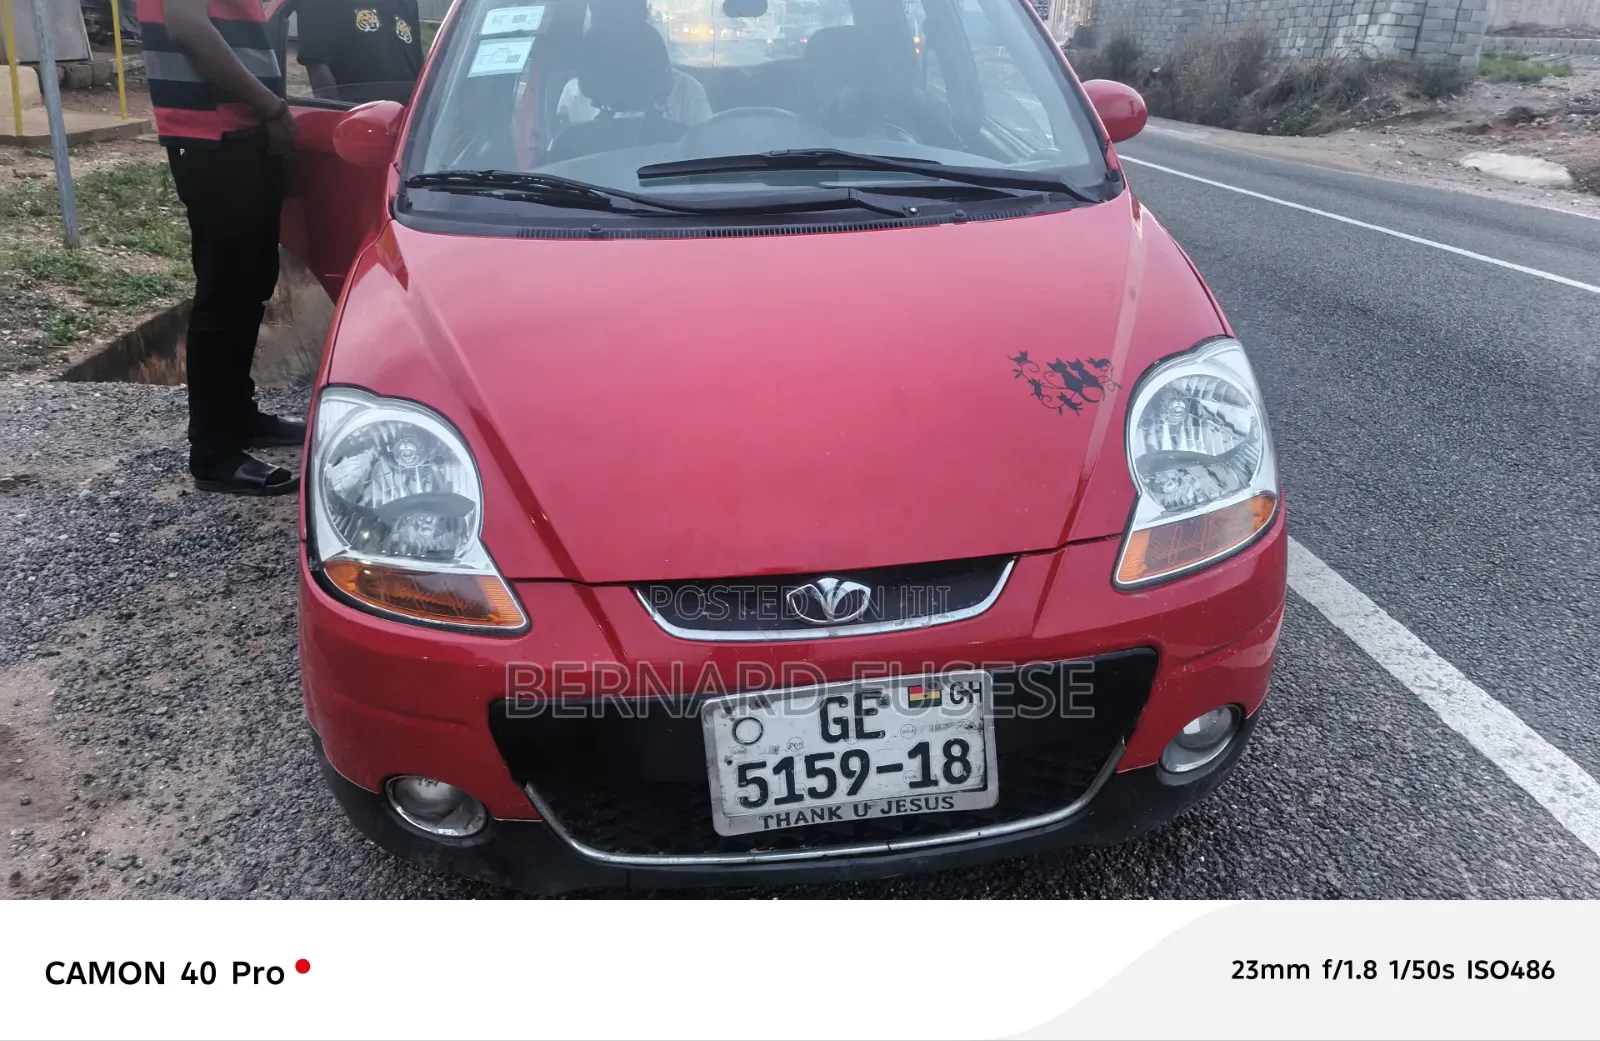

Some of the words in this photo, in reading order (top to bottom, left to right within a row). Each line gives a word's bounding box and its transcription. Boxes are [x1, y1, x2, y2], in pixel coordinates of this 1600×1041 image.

[949, 681, 982, 705] GH
[819, 689, 886, 743] GE
[737, 738, 972, 809] 5159-18
[759, 805, 844, 829] THANK
[853, 803, 869, 817] U
[880, 796, 955, 815] JESUS
